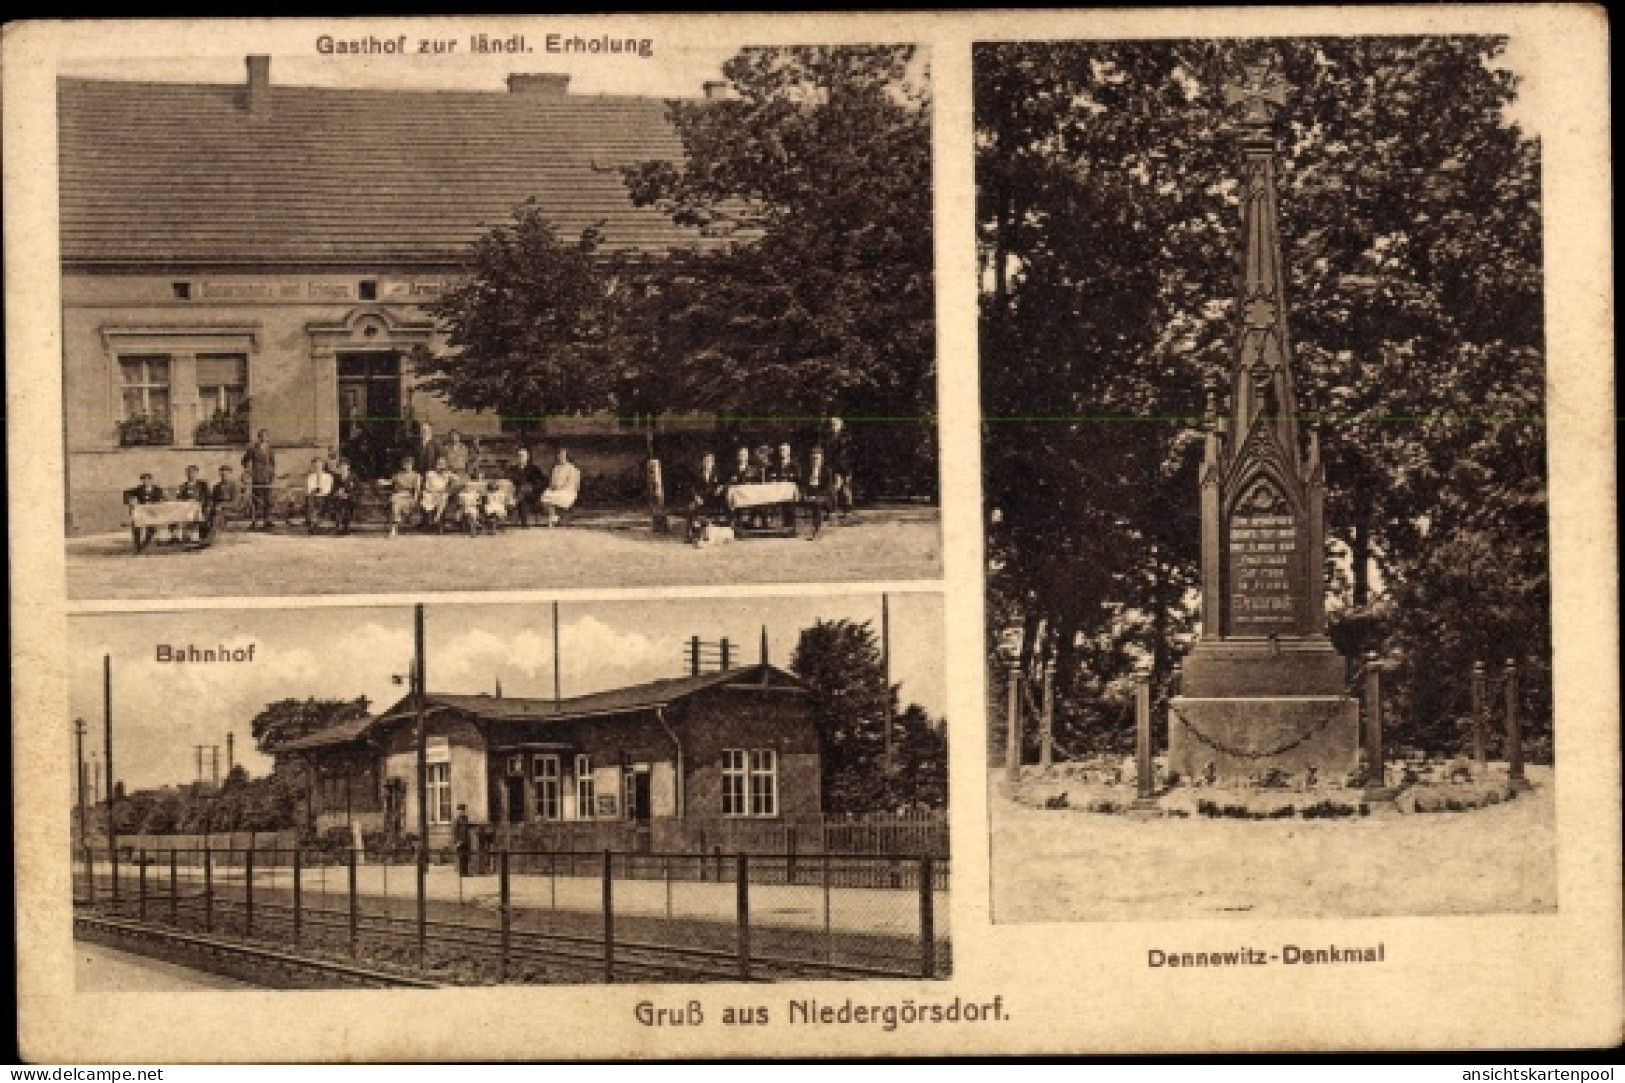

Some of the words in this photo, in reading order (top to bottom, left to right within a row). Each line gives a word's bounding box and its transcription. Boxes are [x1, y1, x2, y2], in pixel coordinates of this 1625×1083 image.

[316, 34, 407, 54] Gasthof
[417, 38, 458, 54] zur
[470, 33, 533, 54] ländl.
[545, 33, 654, 58] Erholung
[155, 643, 256, 664] Bahnhof
[1148, 943, 1386, 968] Dennewitz-Denkmal
[634, 999, 705, 1027] Gruß
[722, 1004, 769, 1026] aus
[789, 994, 1010, 1032] Niedergörsdorf.
